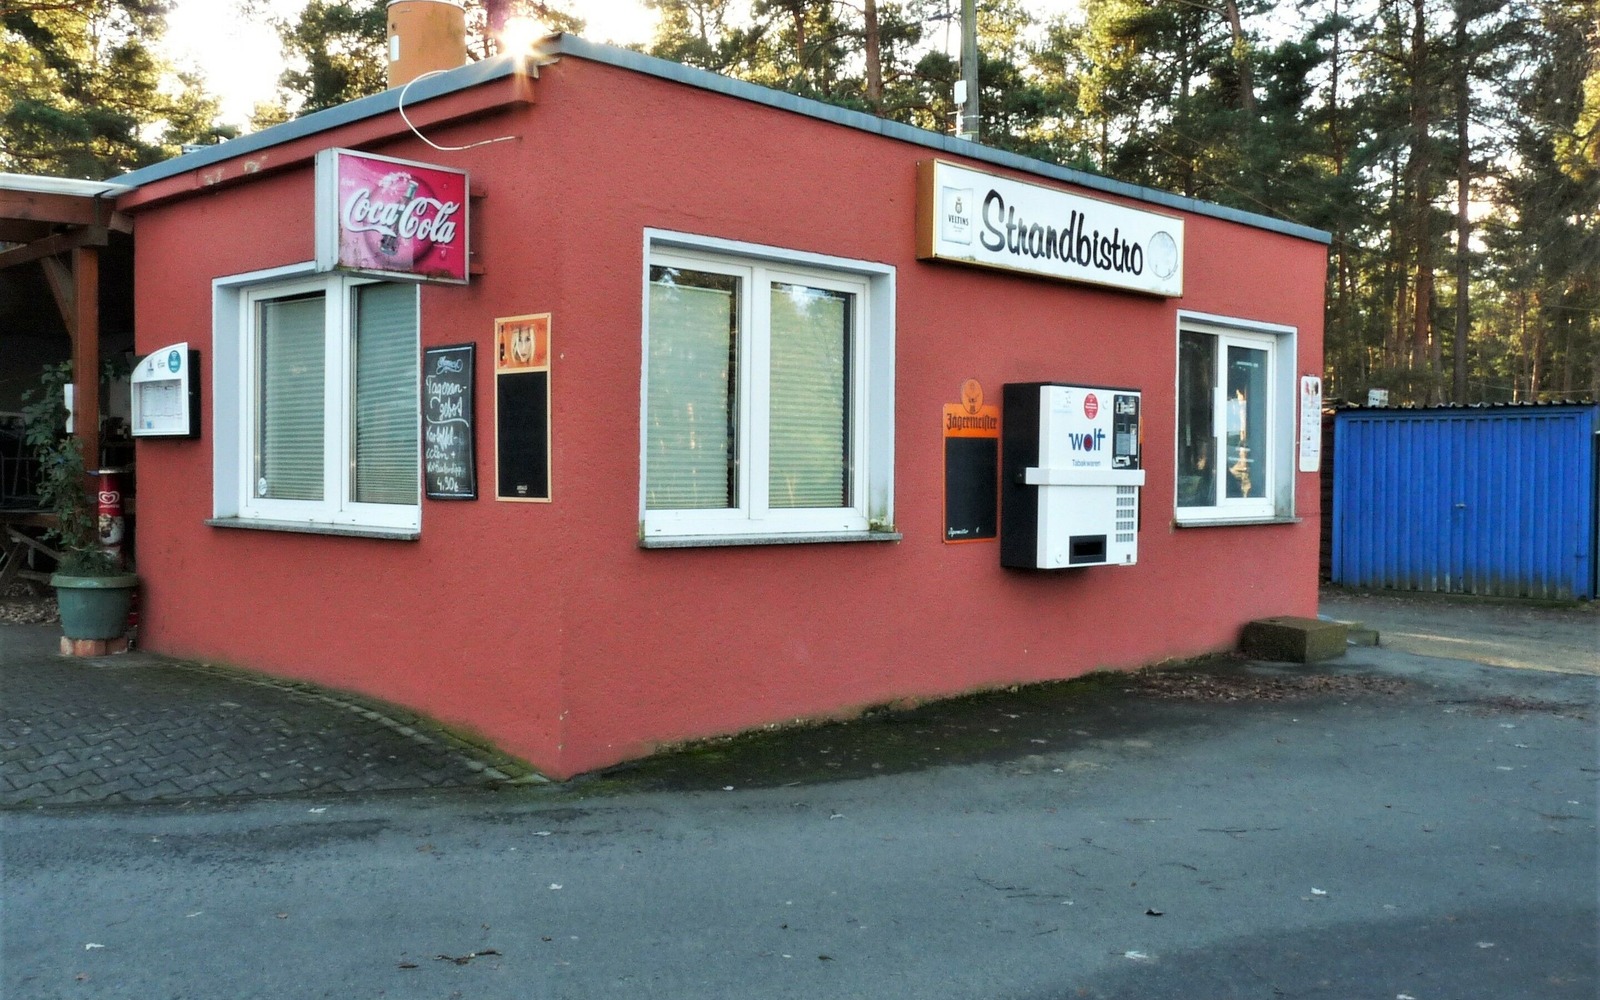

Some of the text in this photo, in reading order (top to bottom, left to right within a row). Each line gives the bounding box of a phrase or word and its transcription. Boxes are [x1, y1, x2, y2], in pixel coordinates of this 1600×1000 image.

[343, 188, 460, 245] Coca-Cola
[948, 214, 969, 226] VELTINS
[979, 188, 1144, 276] Strandbistro
[946, 412, 998, 431] Jägermeister
[1068, 427, 1106, 452] wolf
[1071, 458, 1101, 468] Tabakwaren
